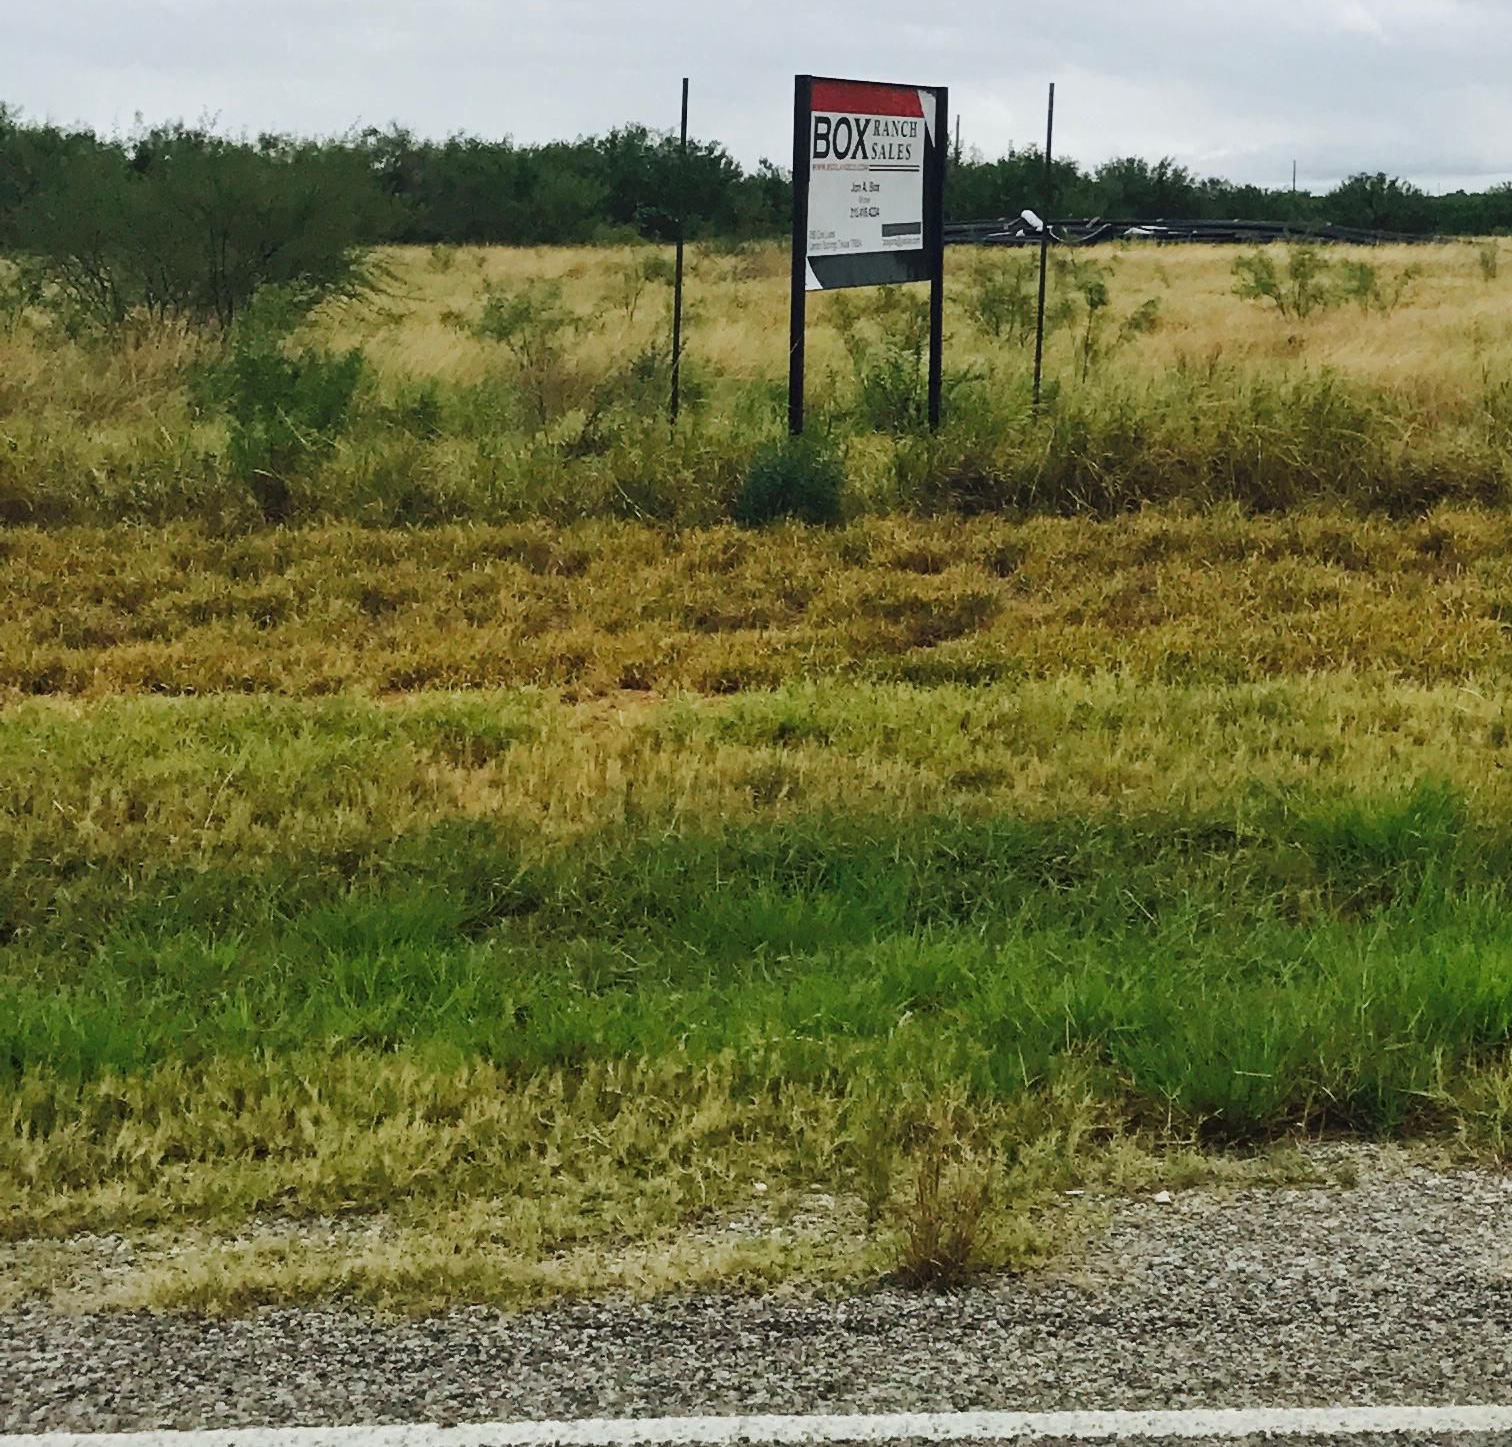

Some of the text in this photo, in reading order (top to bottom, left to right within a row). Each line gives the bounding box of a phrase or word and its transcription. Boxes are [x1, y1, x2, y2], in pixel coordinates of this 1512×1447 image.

[813, 116, 871, 160] BOX
[873, 119, 918, 138] RANCH
[871, 142, 912, 160] SALES
